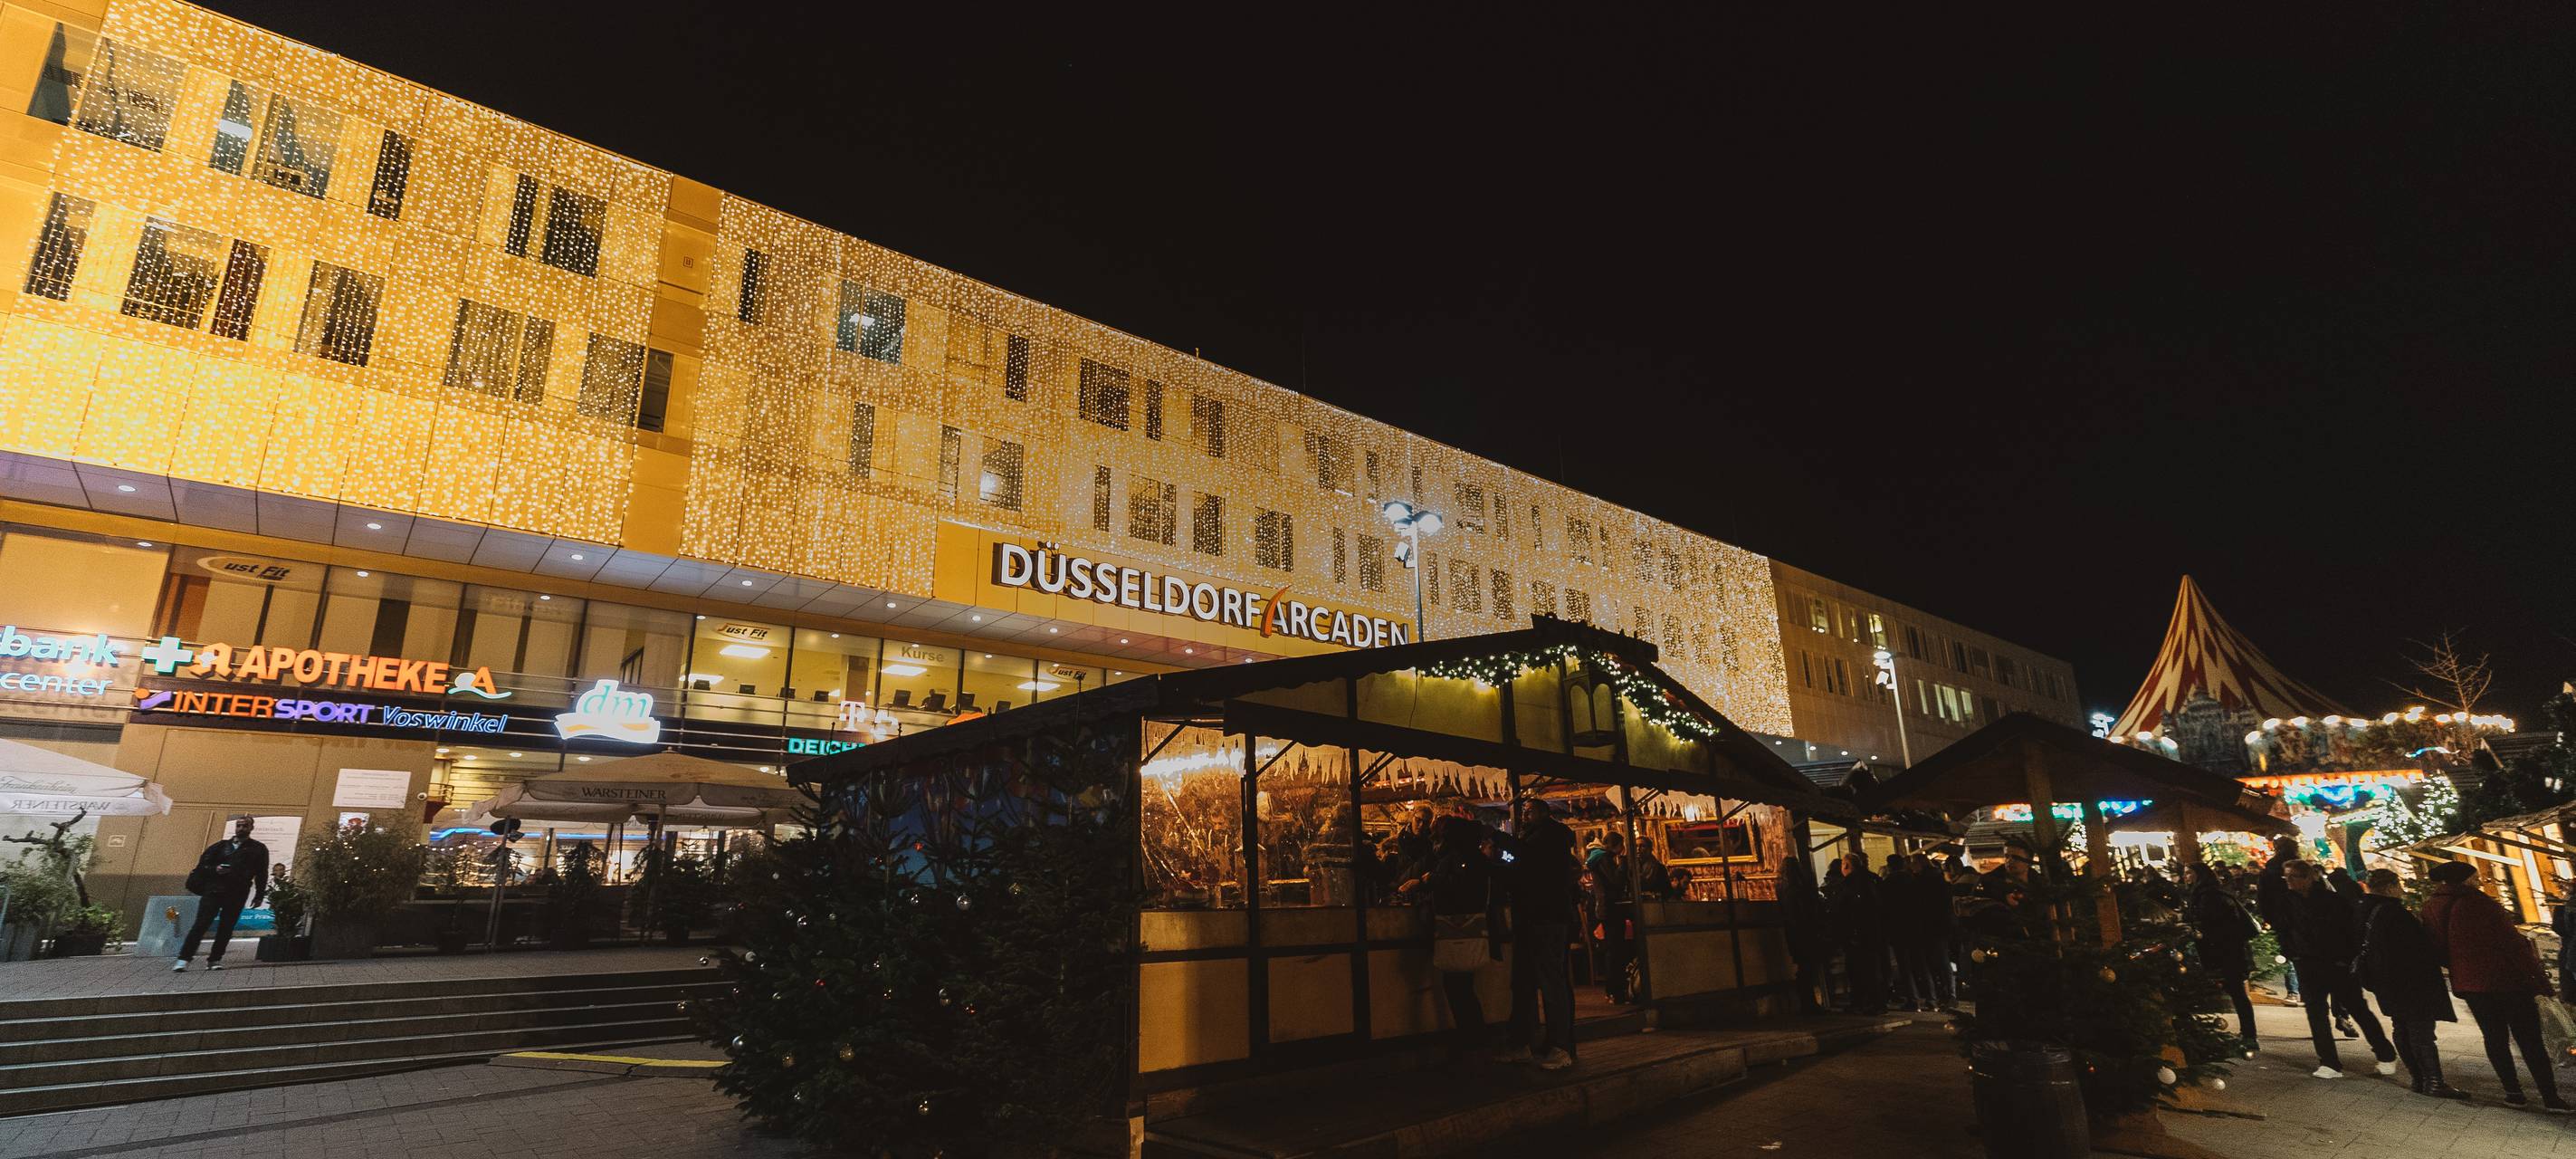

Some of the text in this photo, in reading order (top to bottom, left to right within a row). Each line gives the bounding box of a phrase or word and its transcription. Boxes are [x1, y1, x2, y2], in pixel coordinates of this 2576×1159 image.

[224, 562, 290, 578] ust Fit
[996, 541, 1409, 648] DÜSSELDORF ARCADEN
[717, 622, 768, 637] Just Fit
[0, 626, 119, 665] bank
[902, 647, 944, 662] Kurse
[236, 646, 450, 694] APOTHEKE
[1051, 666, 1073, 676] Just
[173, 690, 509, 733] INTERSPORT Voswinkel
[582, 685, 648, 717] dm
[581, 787, 666, 799] WARSTEINER
